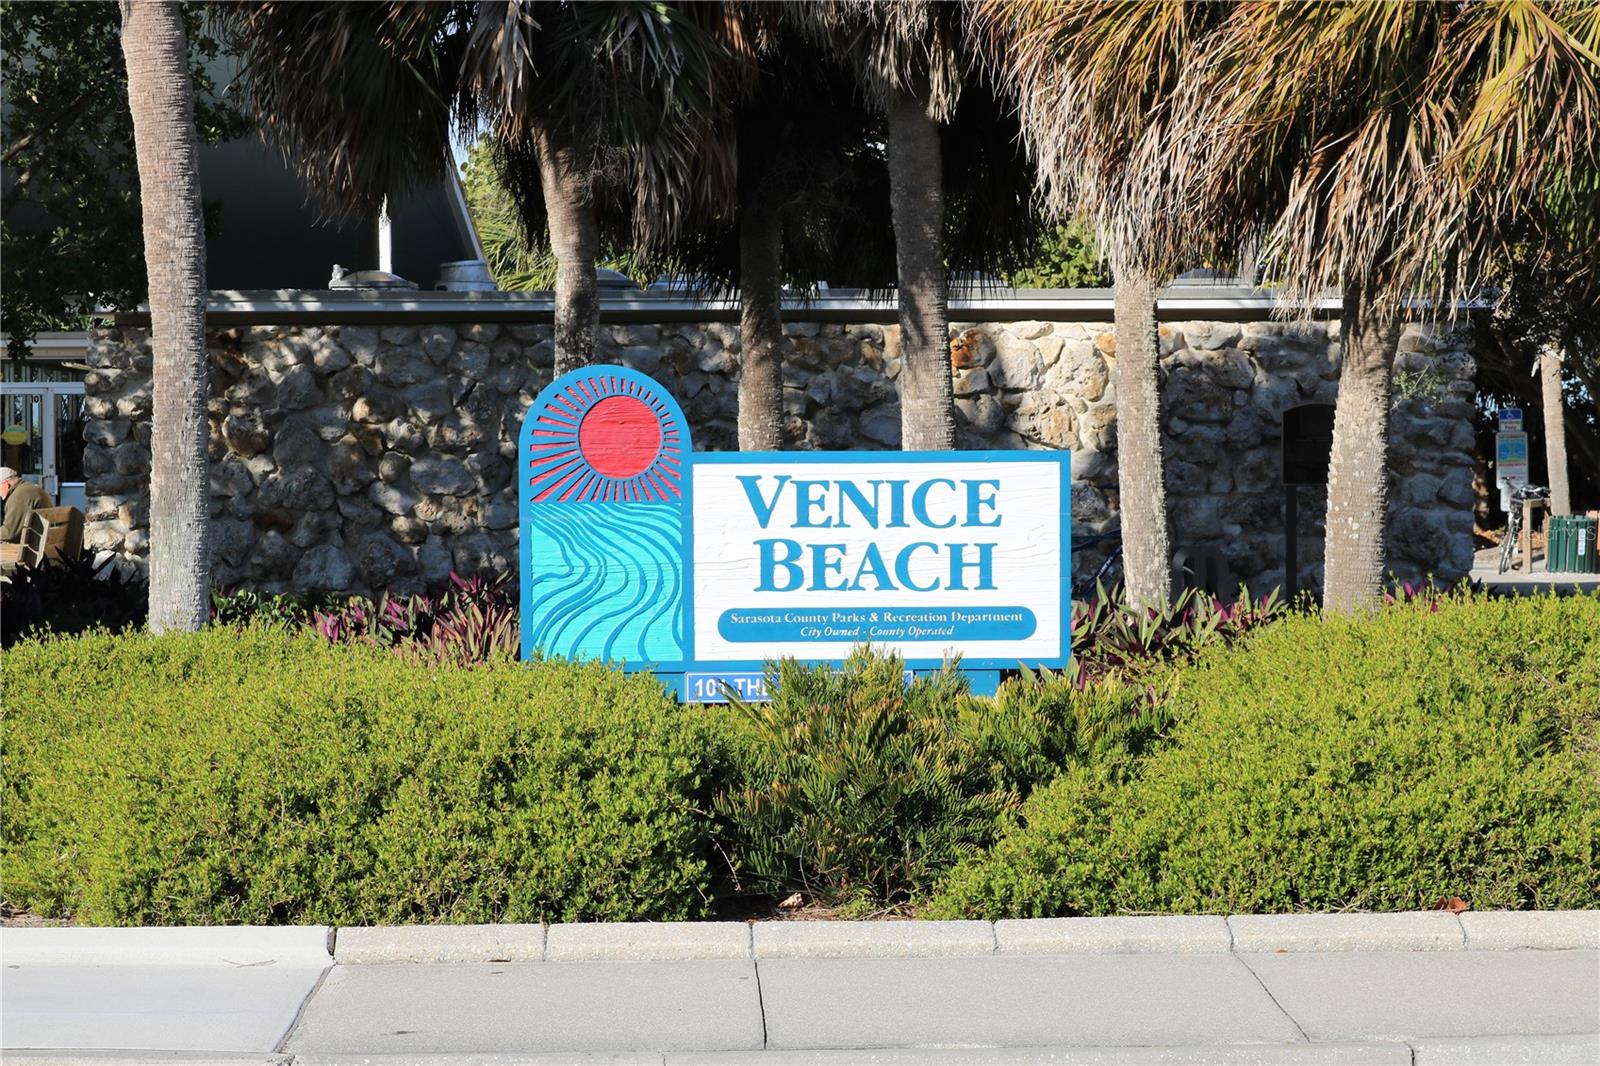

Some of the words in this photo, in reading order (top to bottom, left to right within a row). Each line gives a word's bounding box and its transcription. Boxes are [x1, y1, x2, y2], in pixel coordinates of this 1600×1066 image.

[736, 475, 1002, 530] VENICE
[753, 538, 997, 593] BEACH
[730, 612, 781, 624] Sarasota
[785, 612, 829, 625] County
[832, 612, 866, 623] Parks
[869, 611, 879, 622] &
[884, 611, 947, 622] Recreation
[951, 611, 1023, 625] Department
[800, 626, 822, 638] City
[824, 626, 860, 636] Owned
[869, 626, 905, 638] County
[908, 625, 954, 637] Operated
